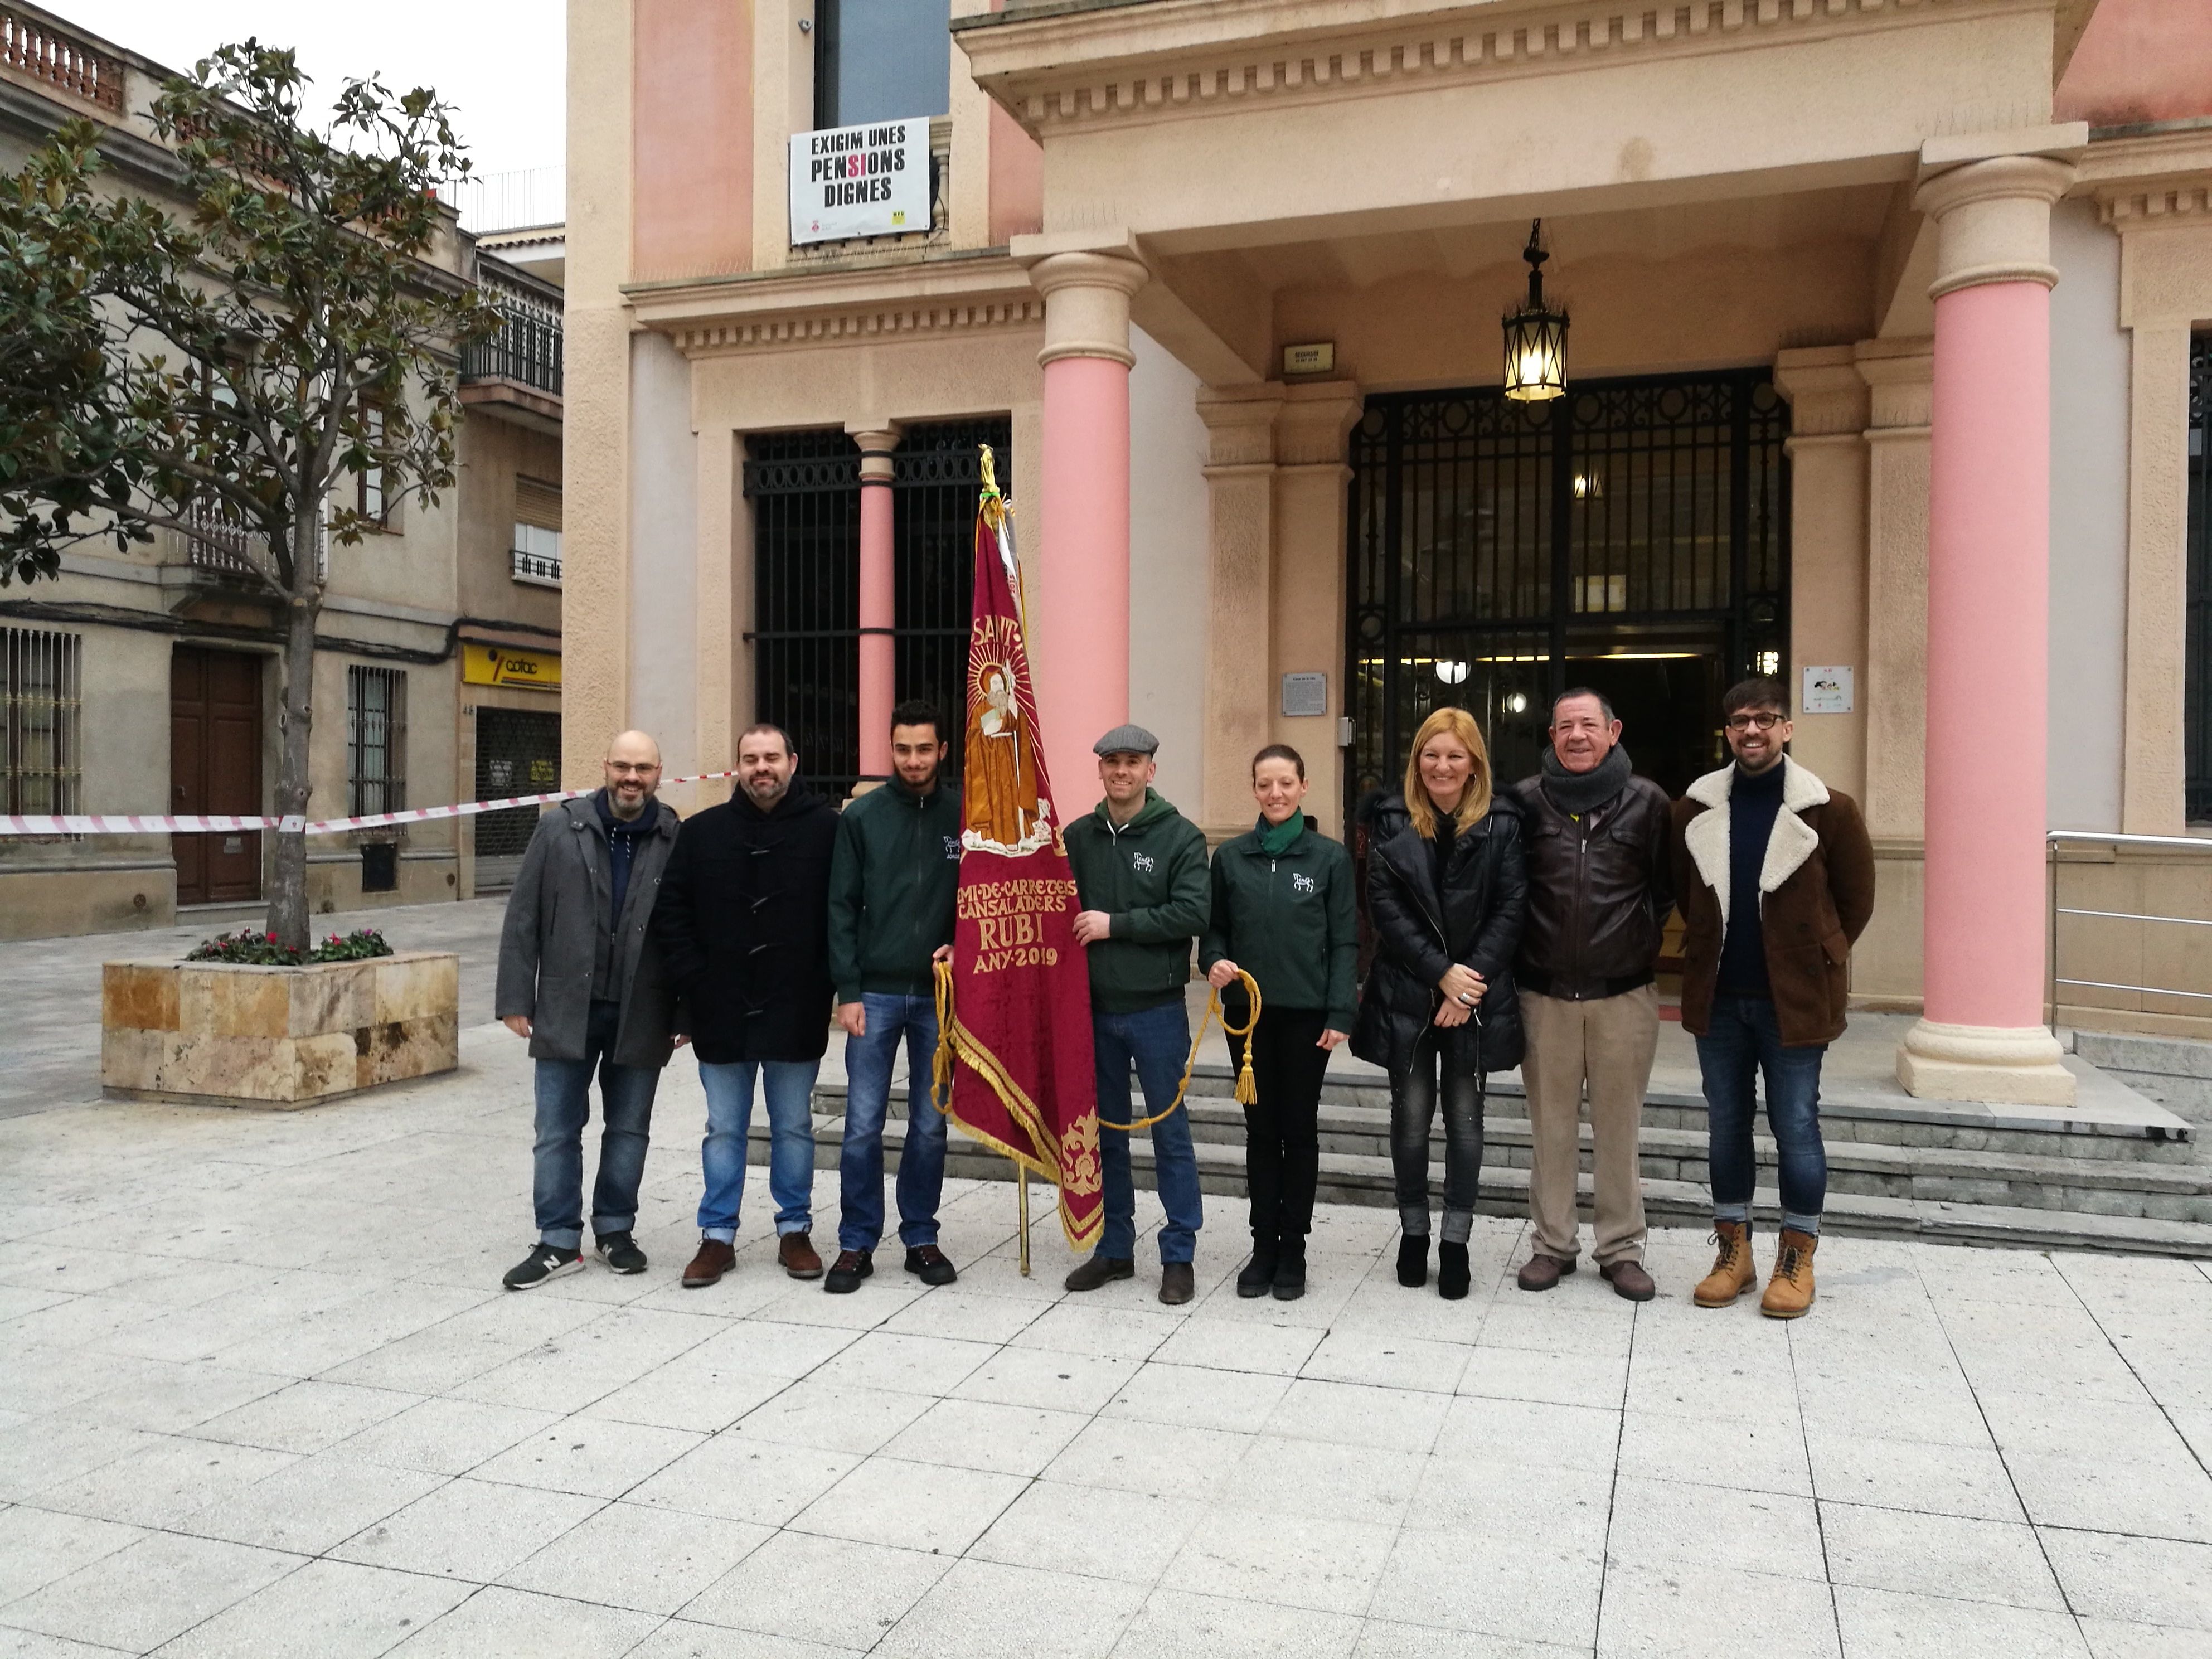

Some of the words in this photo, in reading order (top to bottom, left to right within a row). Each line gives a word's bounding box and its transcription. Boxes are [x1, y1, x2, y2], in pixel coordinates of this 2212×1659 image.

[812, 130, 863, 155] EXIGIM
[869, 125, 905, 147] UNES
[811, 148, 905, 182] PENSIONS
[824, 177, 891, 208] DIGNES
[973, 614, 1018, 646] SANT
[958, 895, 1066, 920] CANSALADERS
[978, 913, 1044, 951] RUBI
